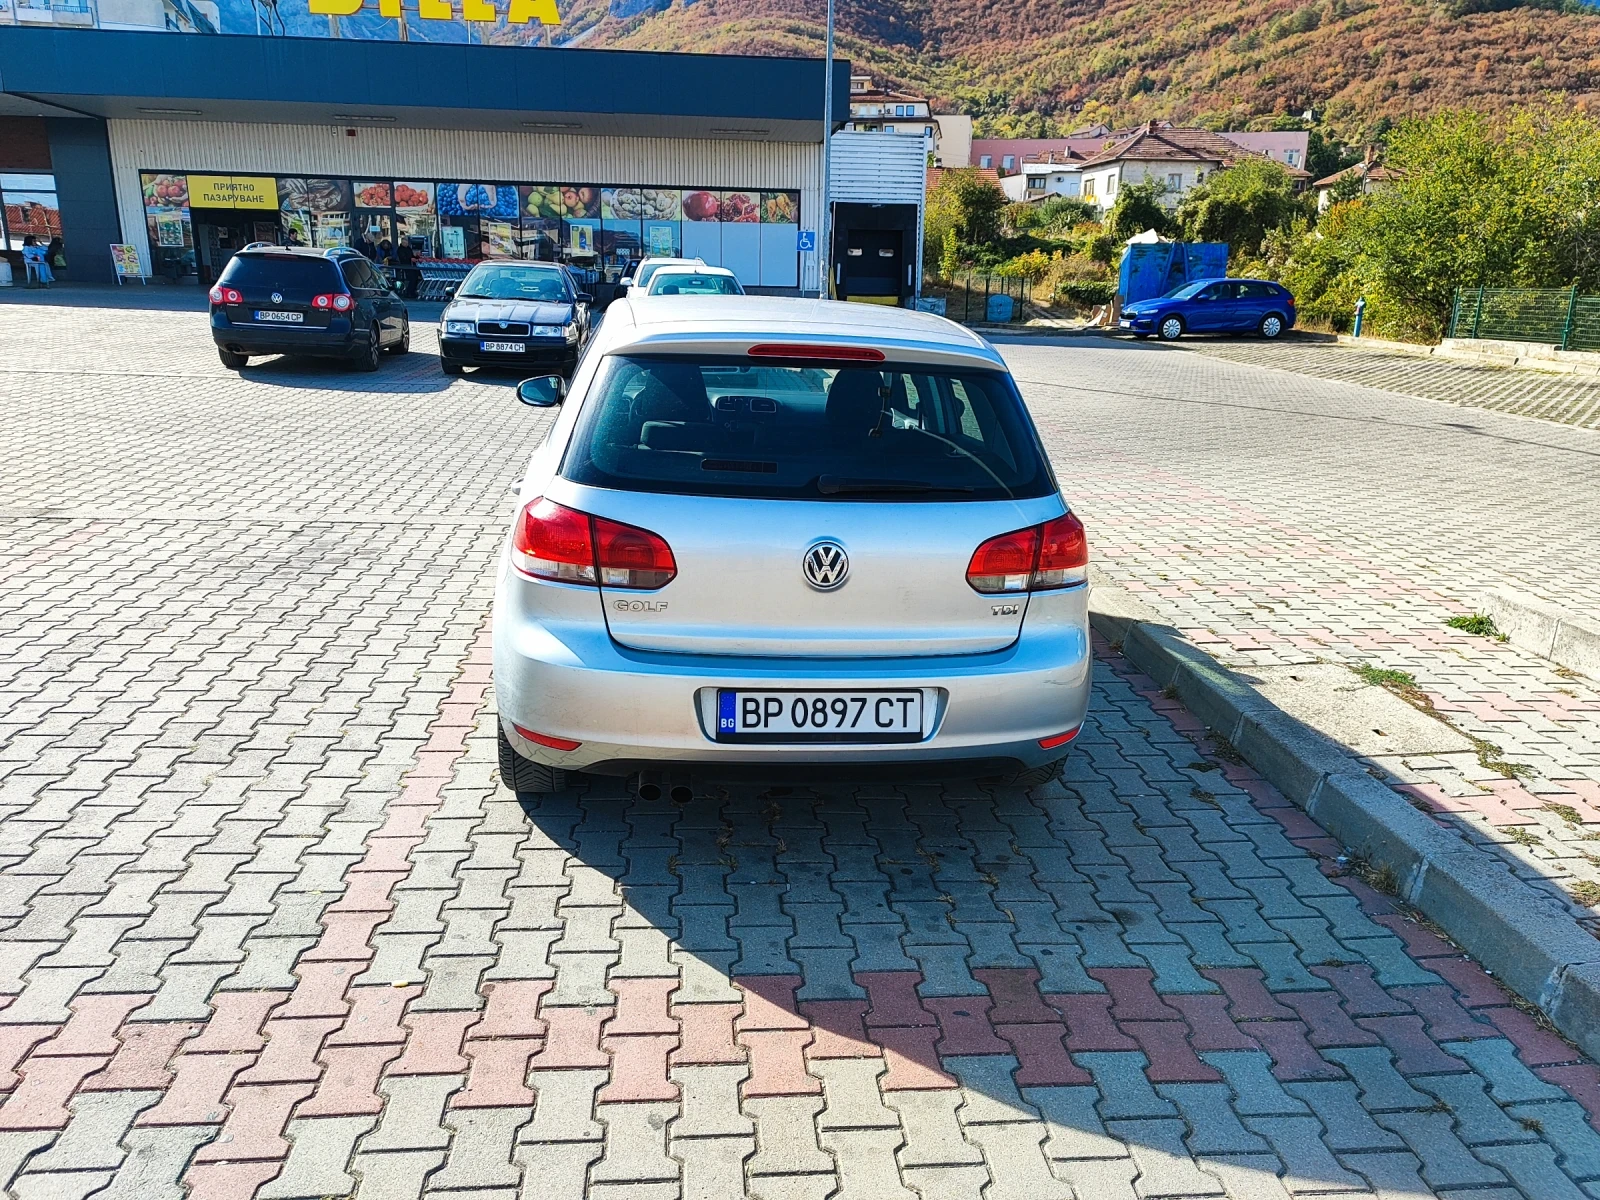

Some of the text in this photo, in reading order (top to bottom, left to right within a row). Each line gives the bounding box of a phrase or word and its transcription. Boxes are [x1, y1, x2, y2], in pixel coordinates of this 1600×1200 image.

[213, 182, 255, 192] ПРИЯТНО
[203, 193, 265, 203] ПАЗАРУВАНЕ
[260, 311, 271, 320] BP
[271, 312, 290, 321] 0654
[613, 600, 669, 612] GOLF
[991, 604, 1020, 616] TDI
[742, 697, 915, 728] BP 0897 CT
[720, 718, 735, 729] BG
